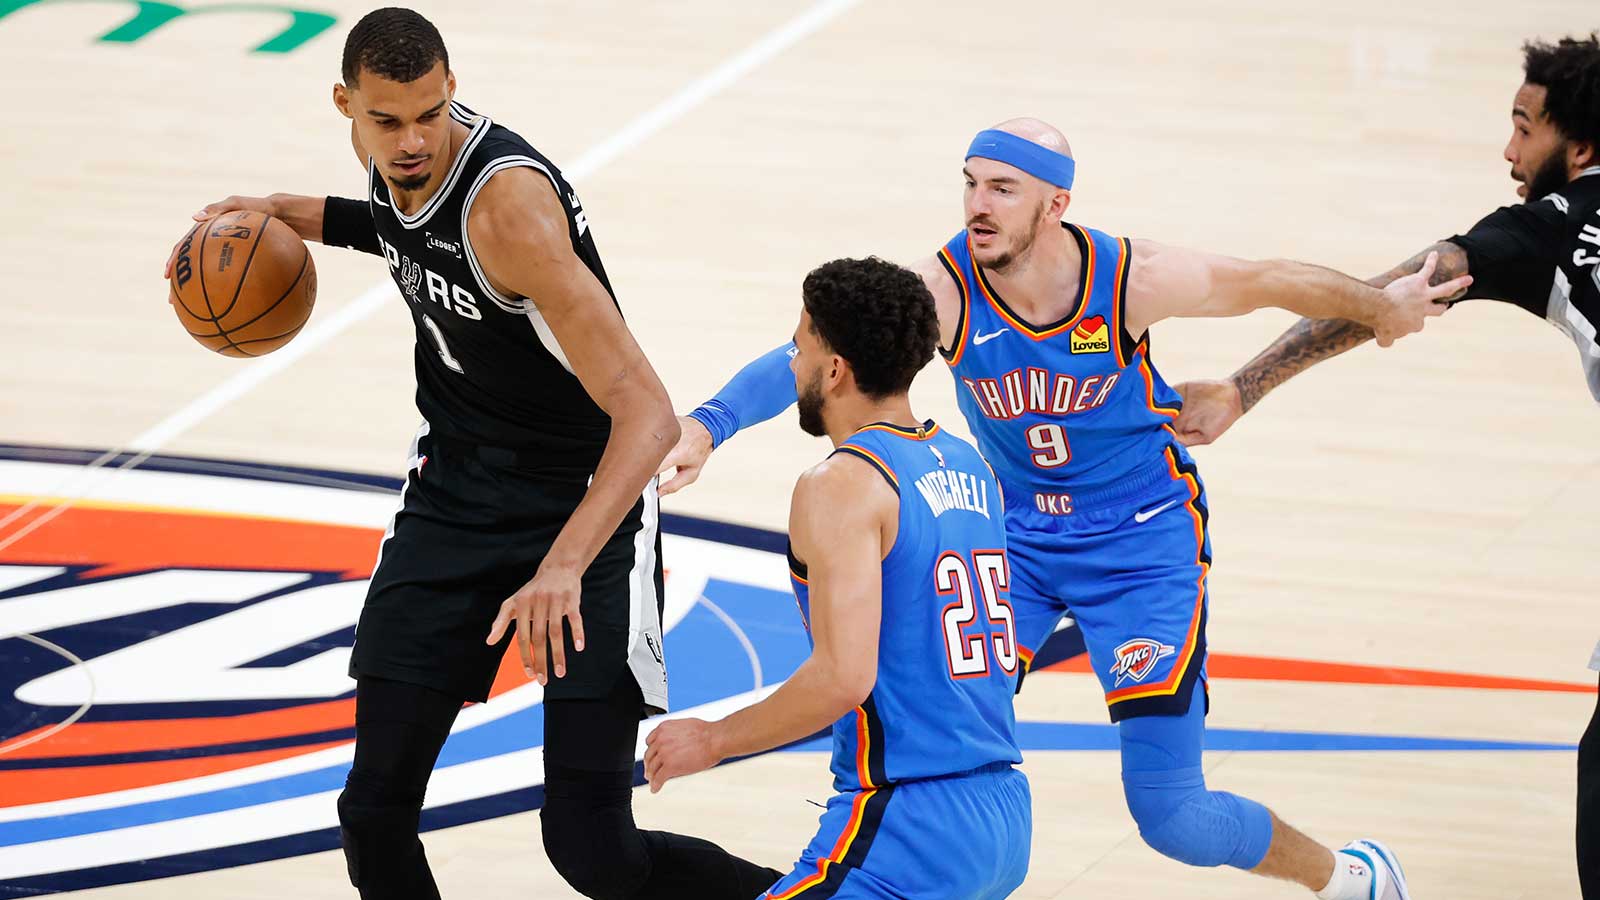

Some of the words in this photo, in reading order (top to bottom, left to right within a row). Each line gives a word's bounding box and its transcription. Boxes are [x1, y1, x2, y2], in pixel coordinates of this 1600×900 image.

[430, 238, 457, 253] LEDGER
[422, 313, 465, 374] 1
[961, 367, 1120, 421] THUNDER
[1025, 423, 1072, 469] 9
[914, 469, 990, 520] MITCHELL
[1036, 493, 1073, 514] OKC
[934, 549, 1019, 681] 25
[1119, 645, 1149, 677] OKC
